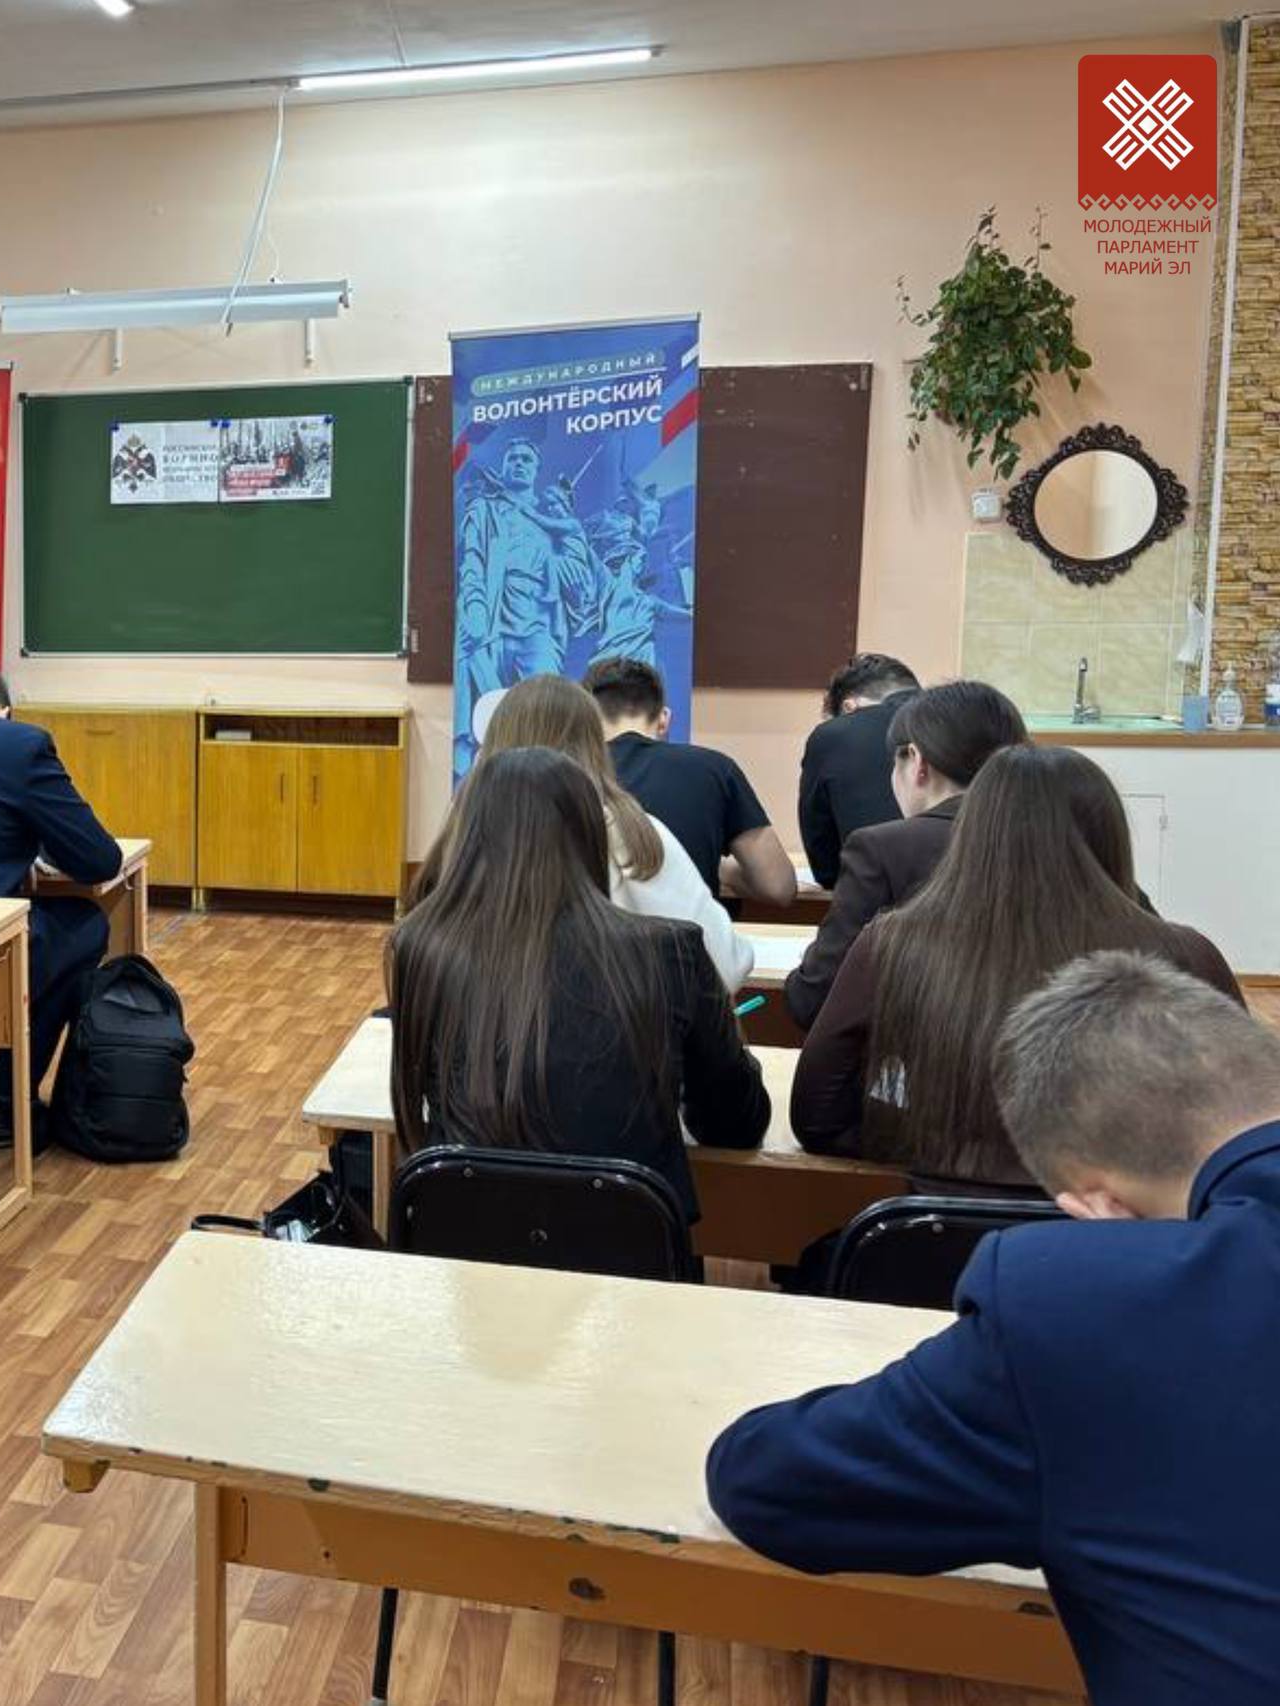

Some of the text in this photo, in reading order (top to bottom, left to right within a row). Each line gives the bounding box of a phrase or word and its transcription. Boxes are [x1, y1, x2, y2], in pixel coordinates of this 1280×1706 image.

[480, 353, 655, 390] МЕЖДУНАРОДНЫЙ
[473, 375, 663, 423] ВОЛОНТЁРСКИЙ
[565, 404, 663, 435] КОРПУС
